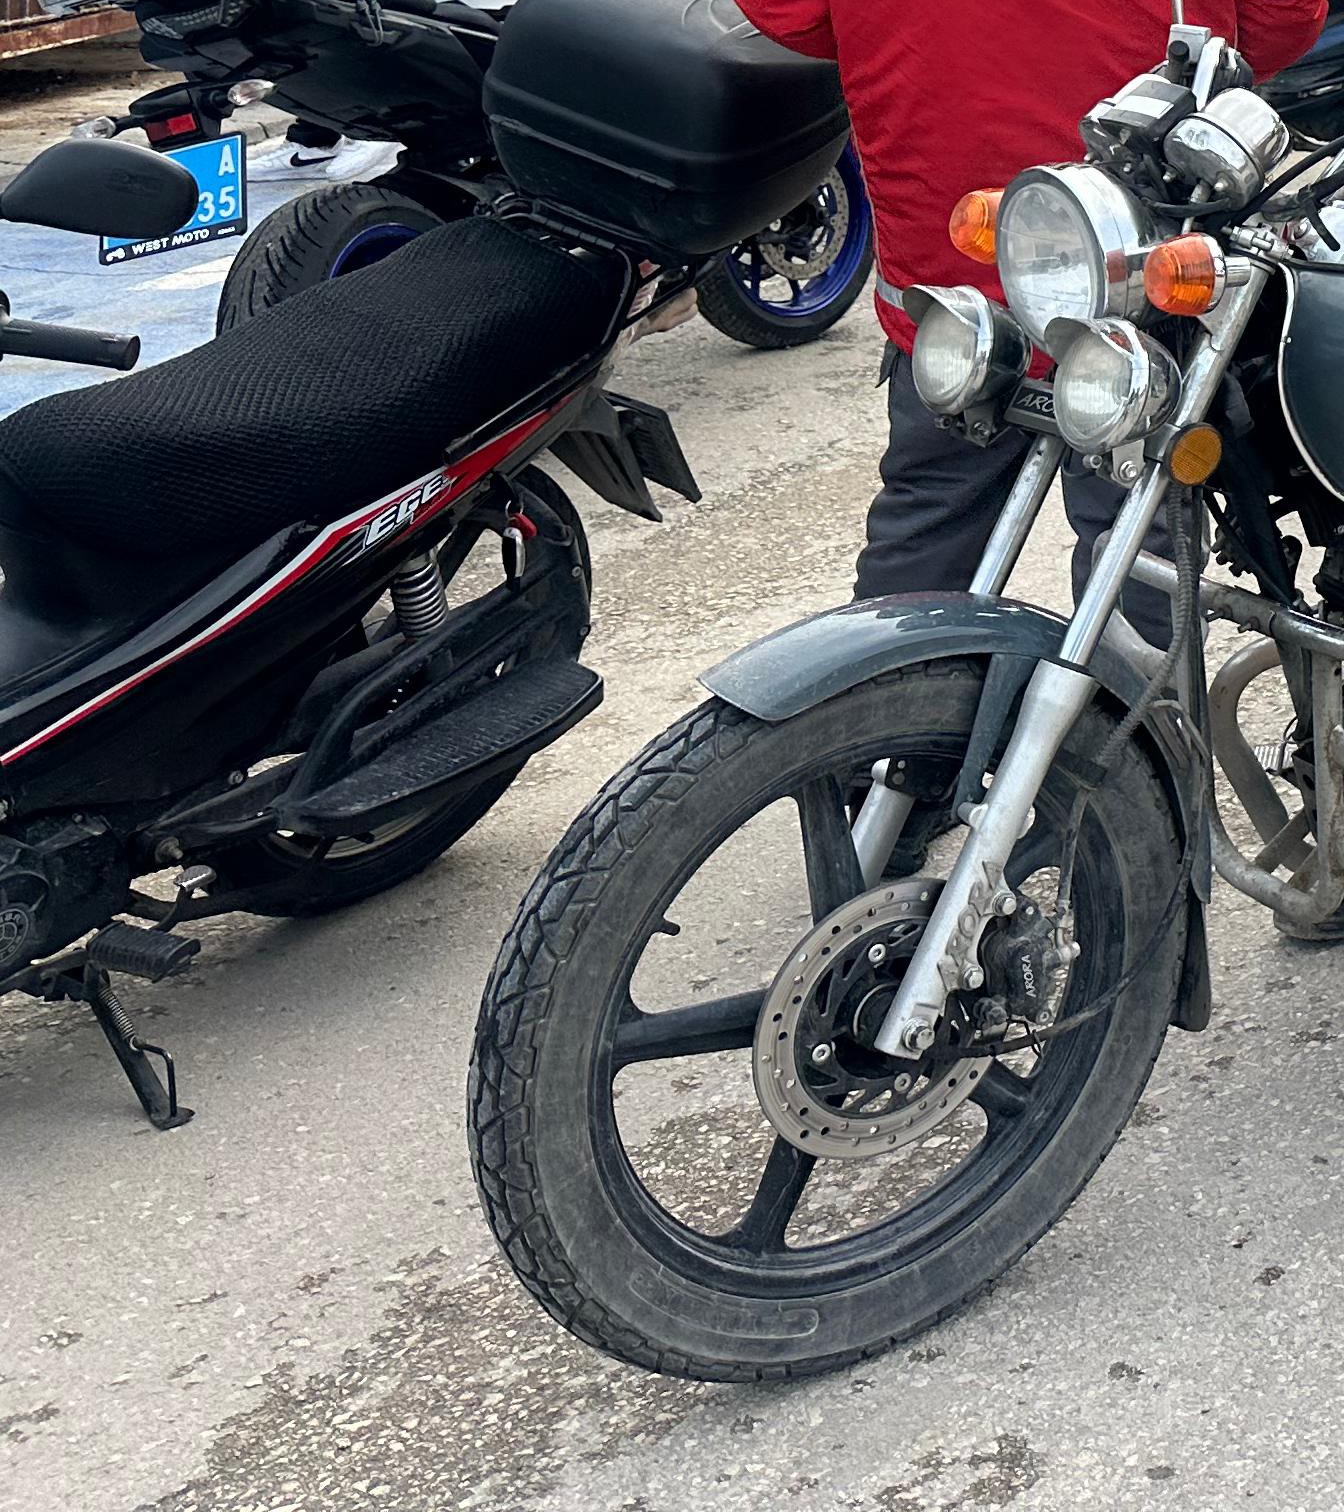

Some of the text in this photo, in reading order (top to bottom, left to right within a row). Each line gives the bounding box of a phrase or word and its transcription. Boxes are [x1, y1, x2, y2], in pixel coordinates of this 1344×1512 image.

[218, 144, 236, 177] A
[192, 186, 236, 224] 35
[131, 237, 170, 256] WEST
[172, 228, 210, 246] MOTO
[1016, 393, 1055, 413] ARO
[1021, 954, 1037, 998] ARORA
